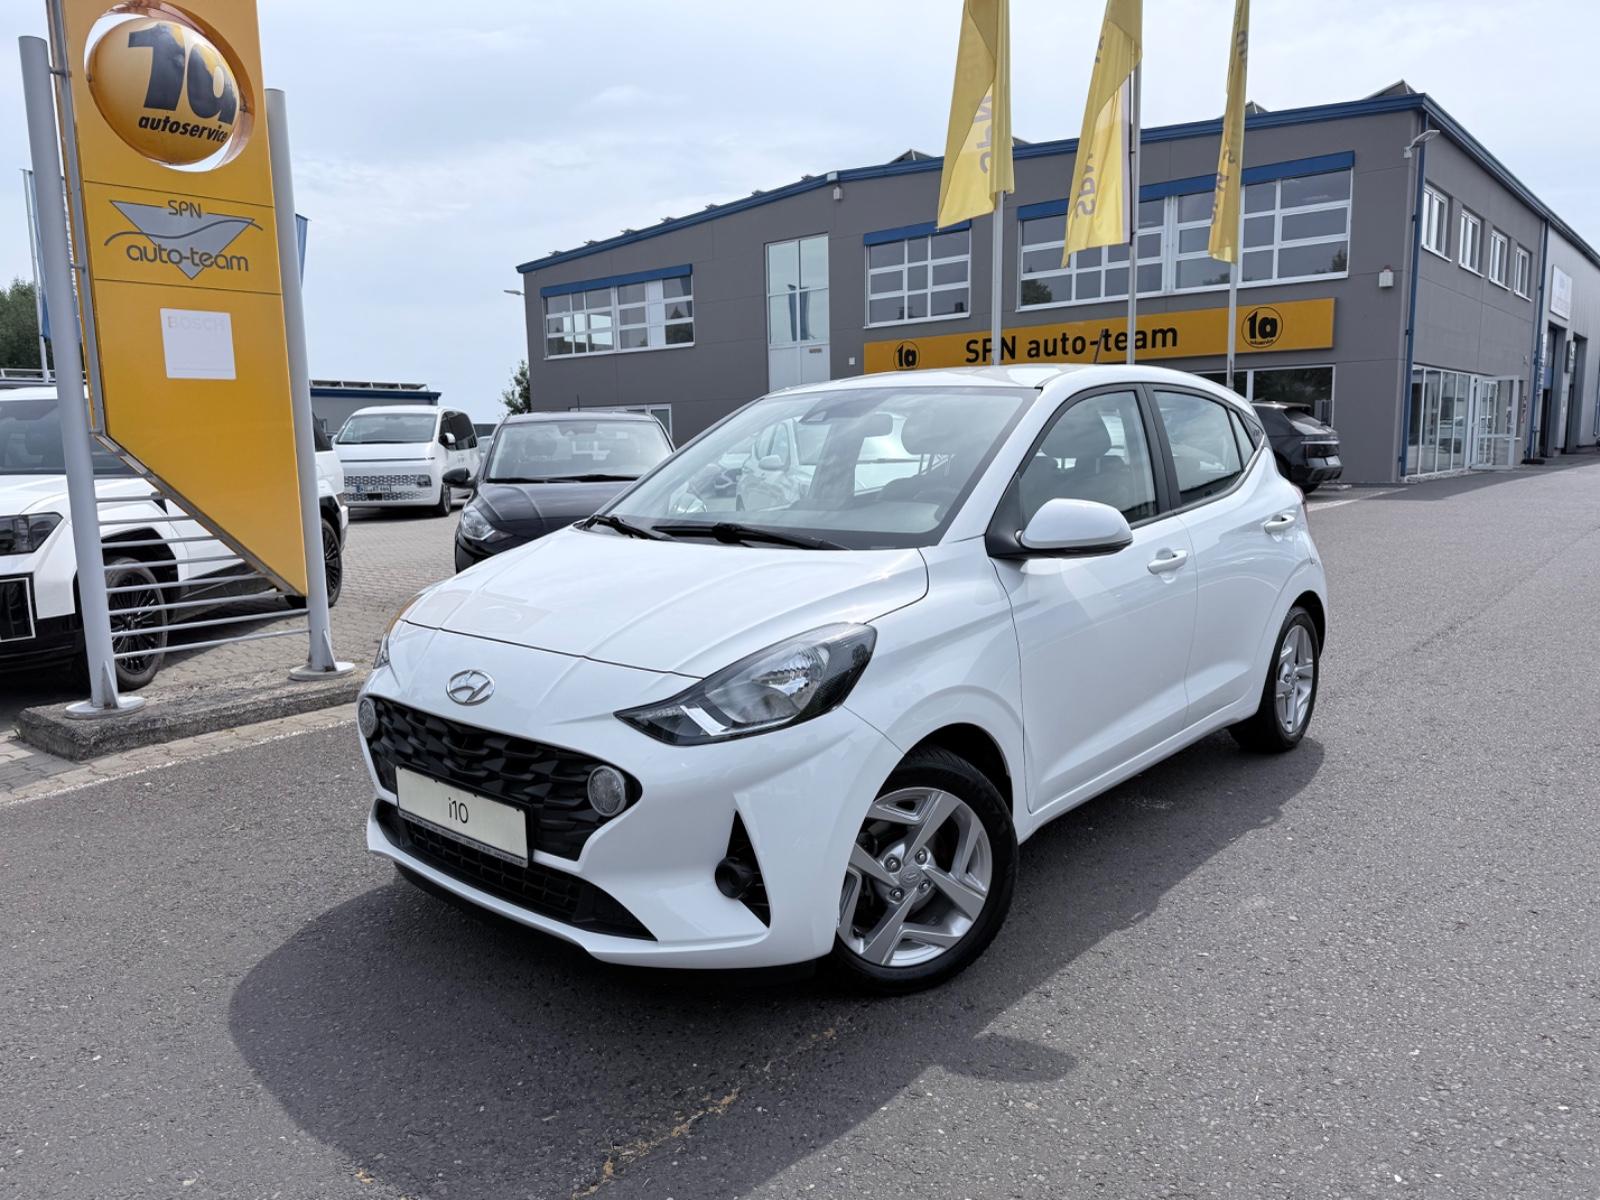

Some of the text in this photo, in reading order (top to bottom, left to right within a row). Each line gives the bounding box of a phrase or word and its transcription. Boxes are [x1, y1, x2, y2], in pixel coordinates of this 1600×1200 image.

[128, 22, 238, 125] 1a
[138, 115, 228, 143] autoservice
[168, 200, 202, 218] SPN
[126, 244, 249, 271] auto-team
[1247, 311, 1278, 339] 1a
[897, 344, 917, 367] 1a
[1027, 327, 1177, 359] auto-team
[448, 797, 469, 824] i10
